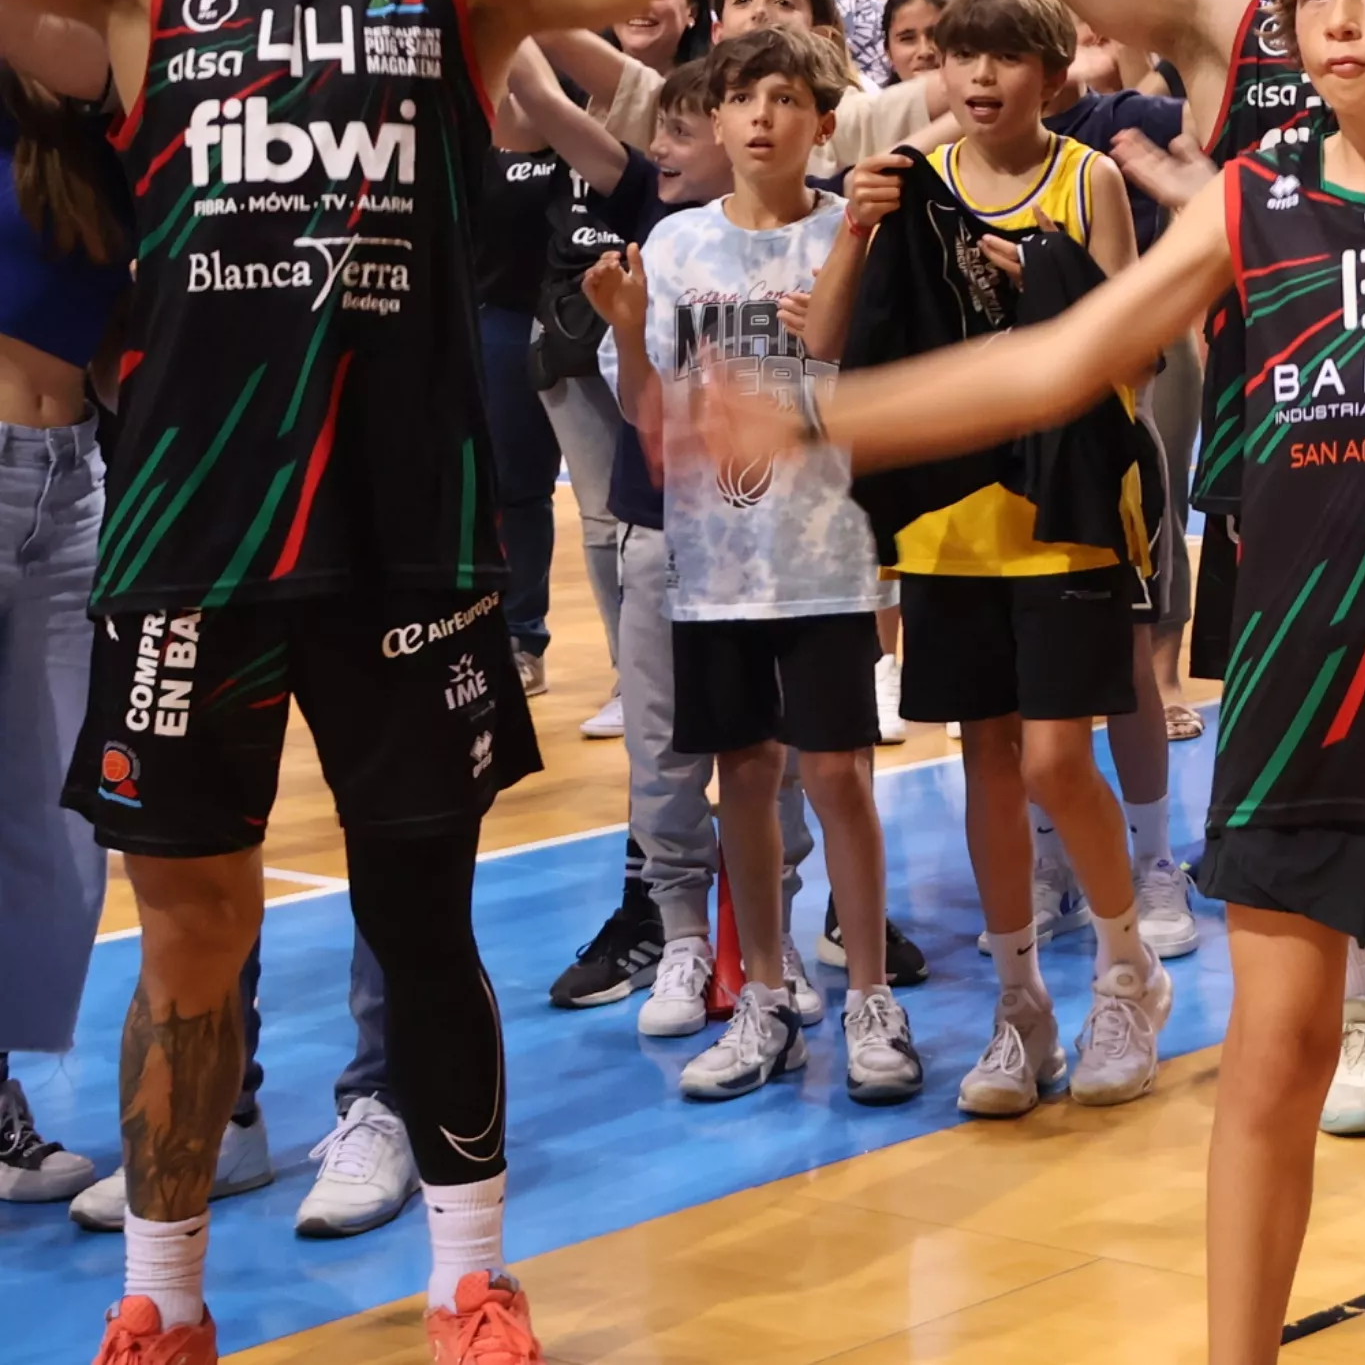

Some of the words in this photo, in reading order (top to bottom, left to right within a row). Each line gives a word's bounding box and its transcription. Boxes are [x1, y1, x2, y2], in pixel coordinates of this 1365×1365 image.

[257, 4, 355, 77] 44
[167, 47, 244, 83] alsa
[184, 96, 416, 187] fibwi
[194, 199, 238, 216] FIBRA
[248, 191, 310, 212] MÓVIL
[321, 194, 347, 211] TV
[1290, 440, 1338, 469] SAN
[444, 670, 488, 711] IME
